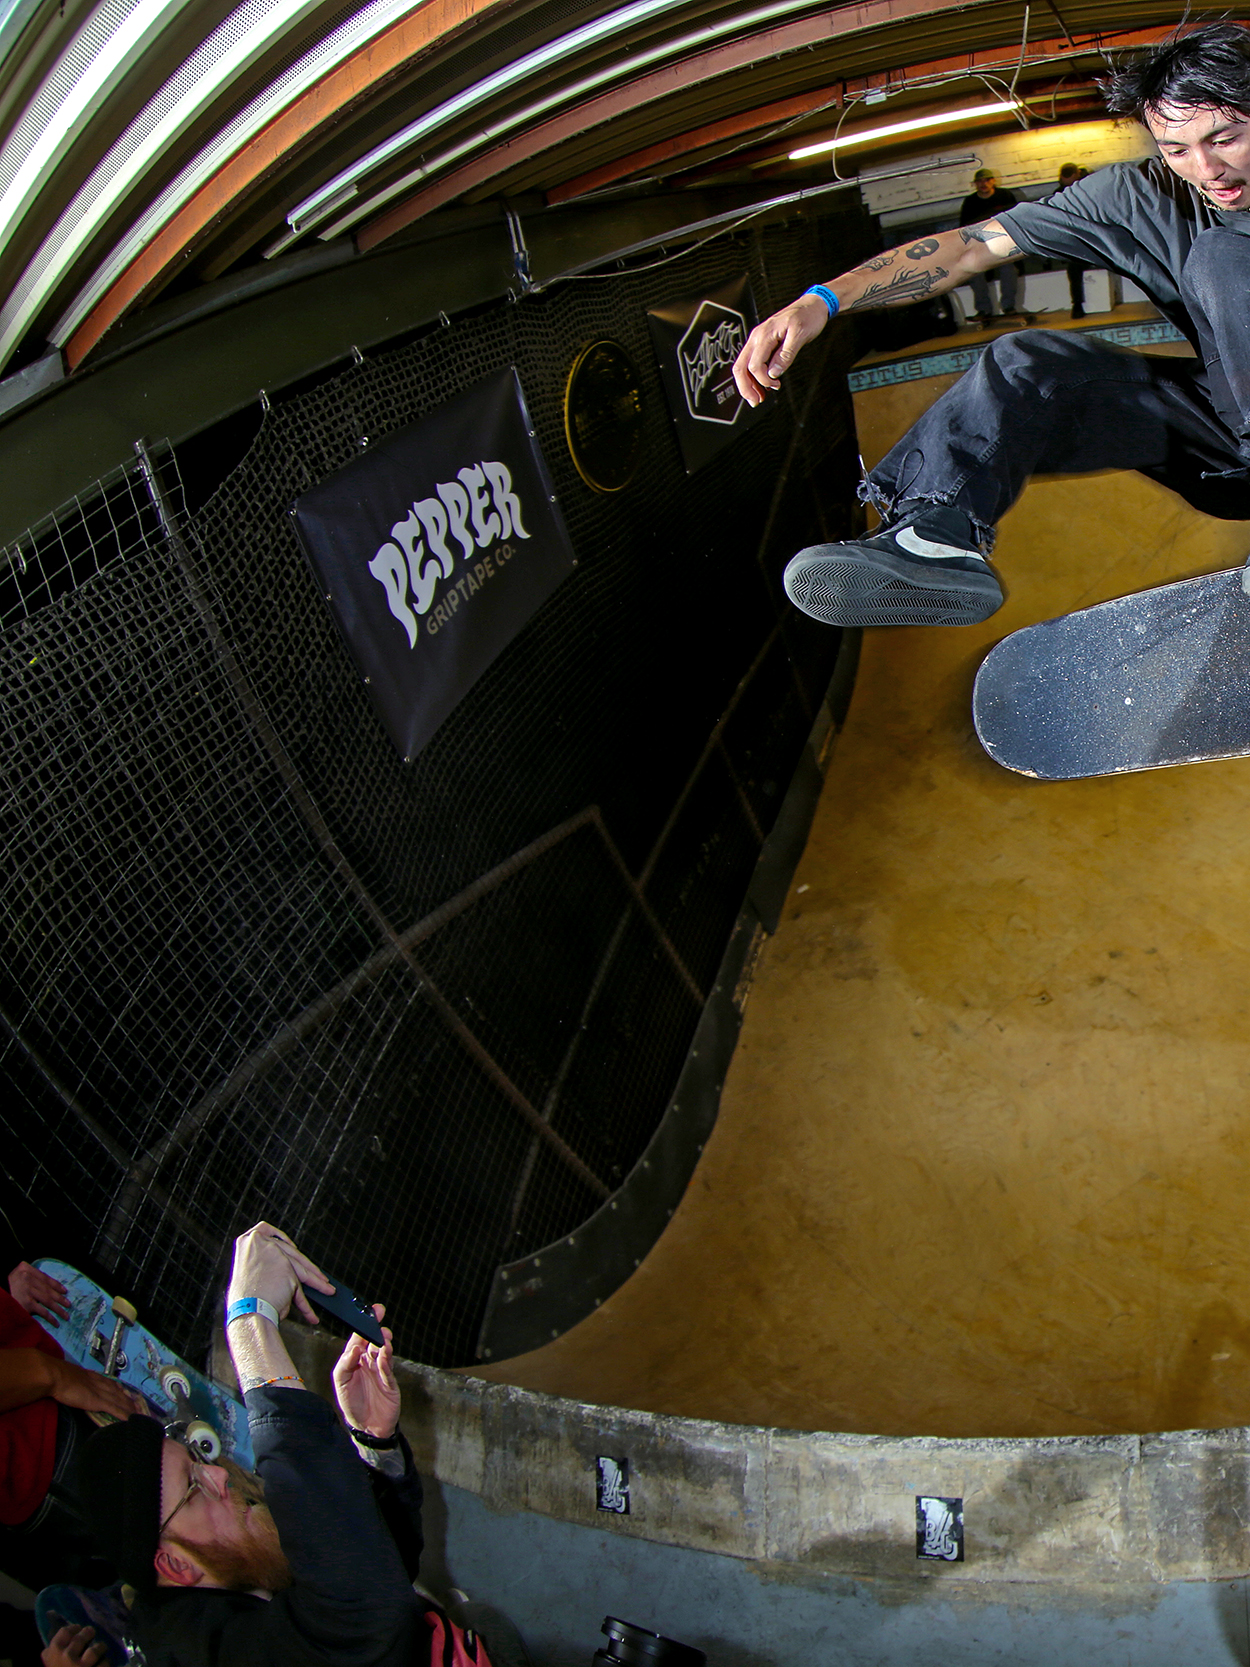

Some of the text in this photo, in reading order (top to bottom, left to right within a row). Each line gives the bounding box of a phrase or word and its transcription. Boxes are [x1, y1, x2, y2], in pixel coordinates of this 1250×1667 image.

[851, 361, 922, 388] TITUS
[368, 461, 532, 650] PEPPER
[426, 557, 496, 635] GRIPTAPE
